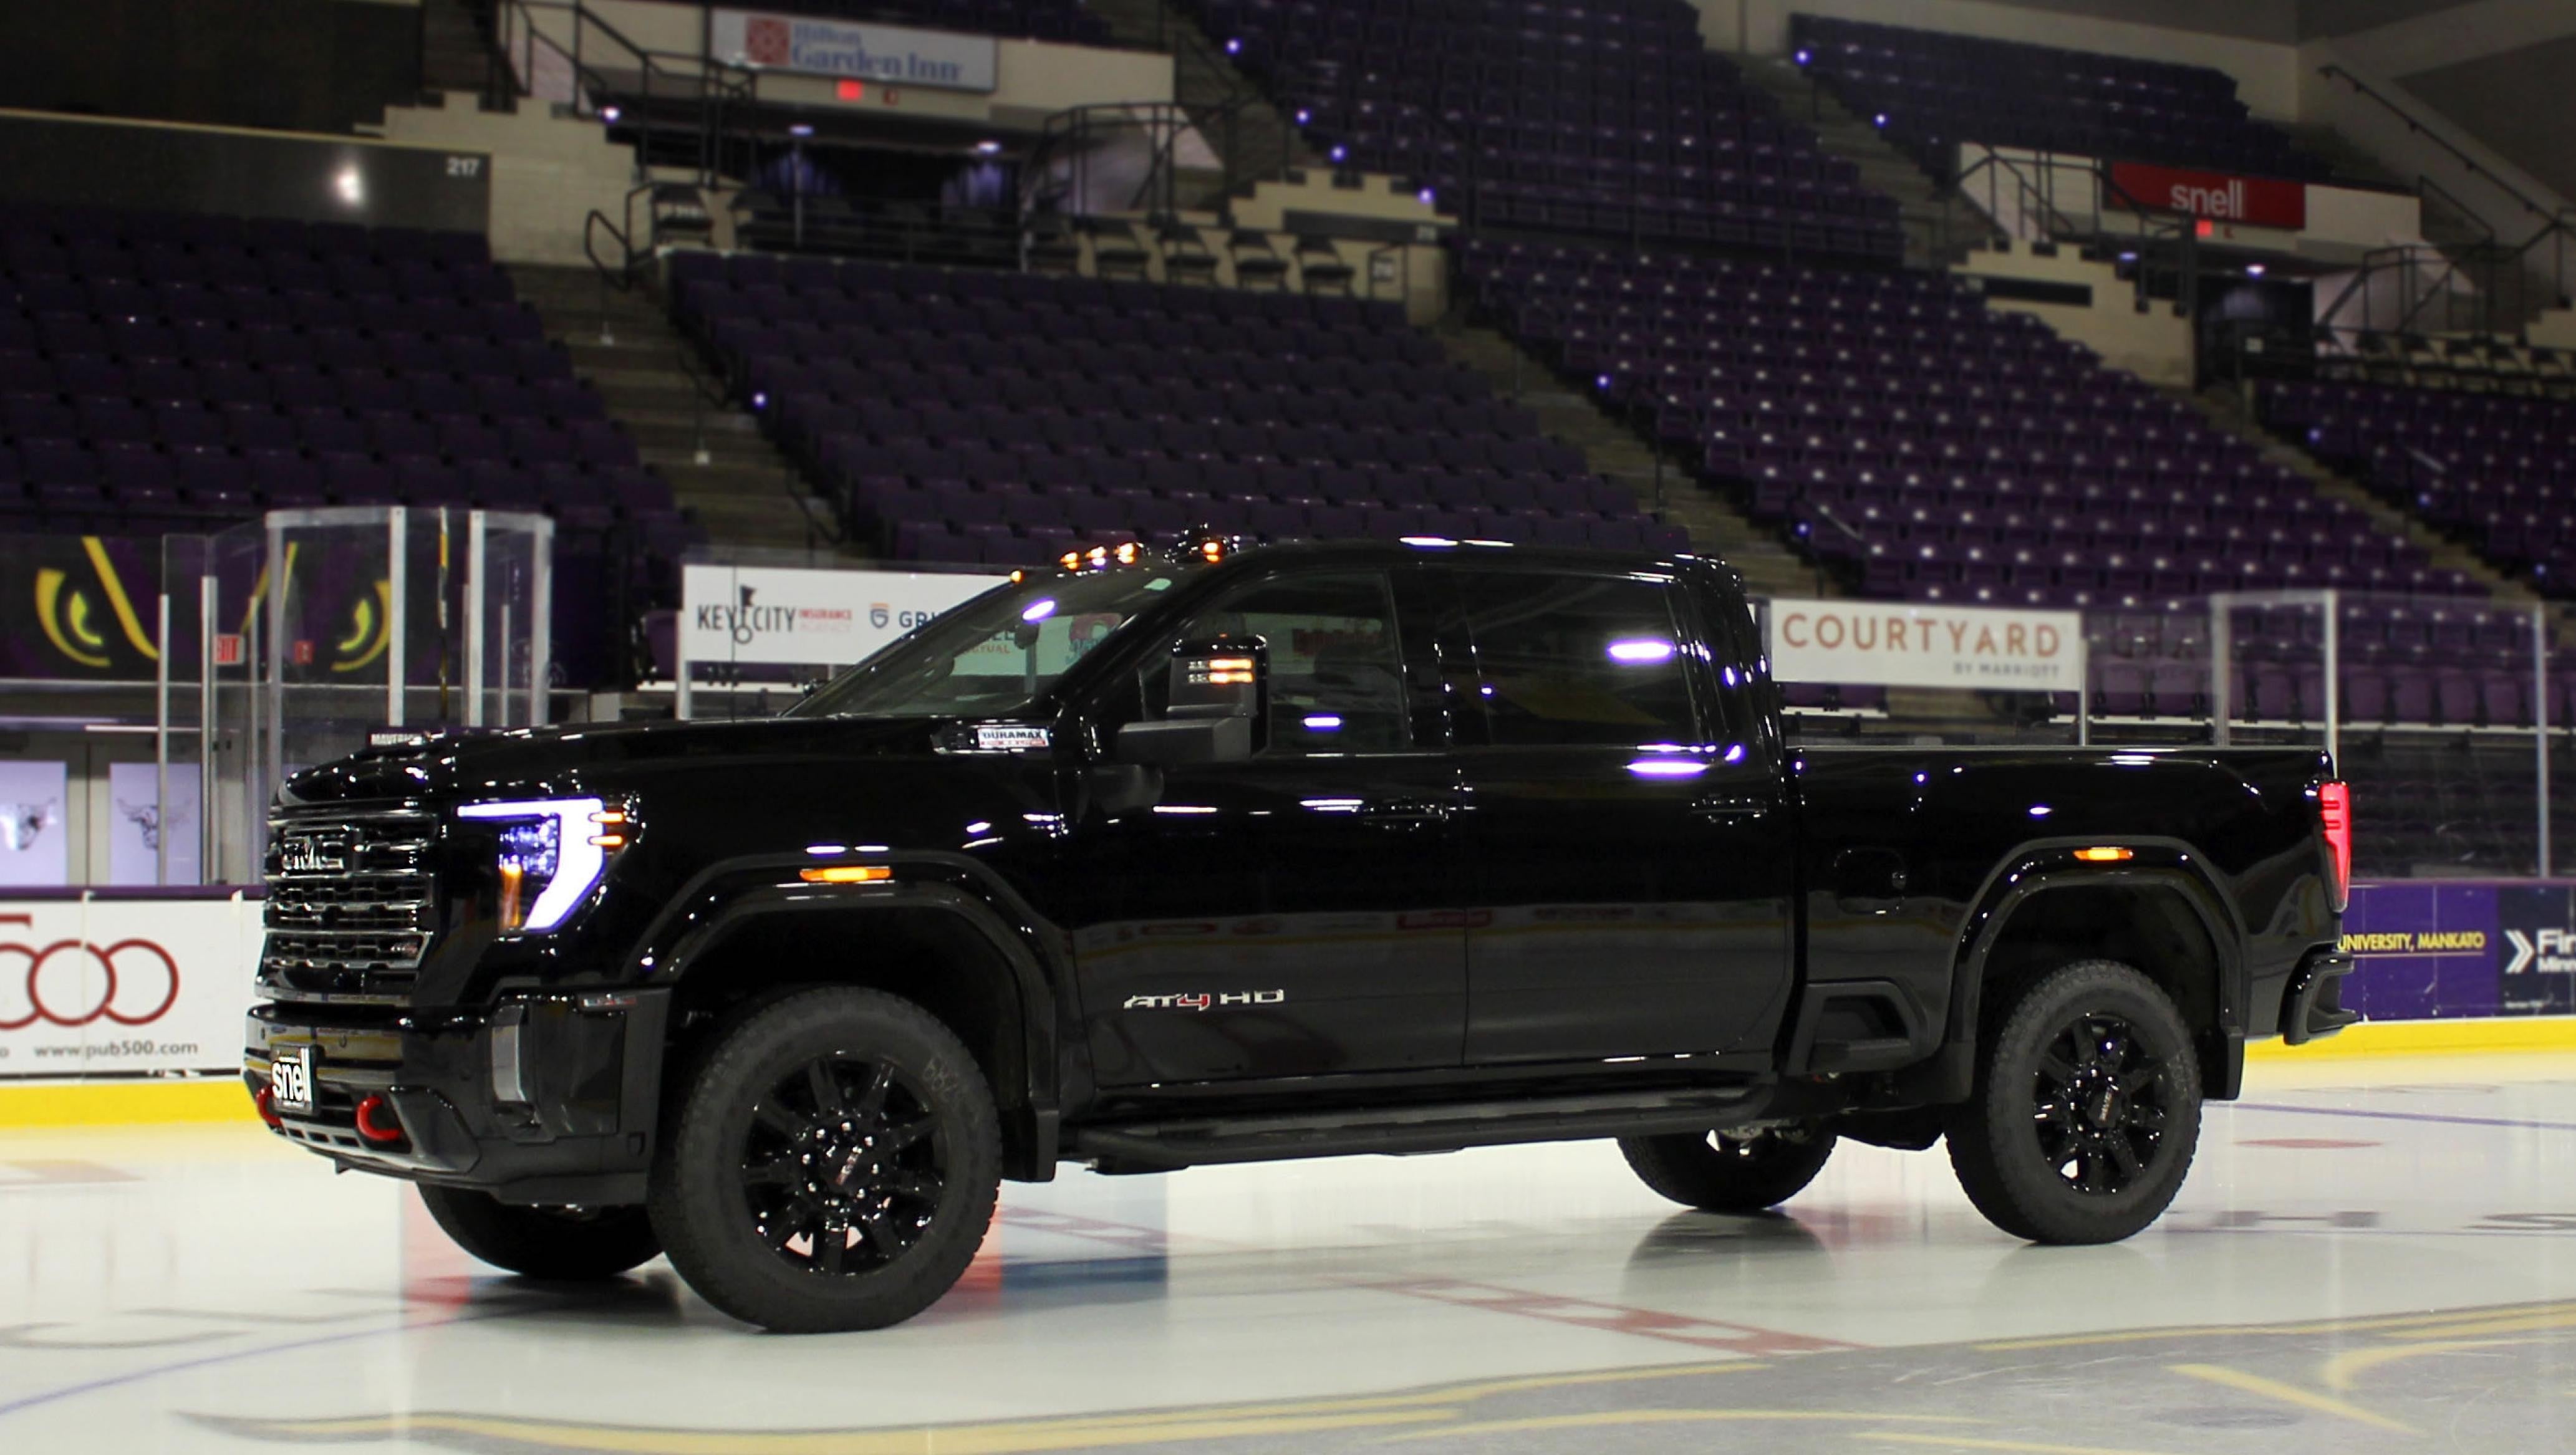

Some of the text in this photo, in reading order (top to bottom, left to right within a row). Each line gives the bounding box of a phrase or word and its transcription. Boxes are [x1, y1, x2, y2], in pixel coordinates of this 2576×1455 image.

[793, 24, 861, 45] Hilton
[792, 45, 962, 81] Garden Inn
[447, 157, 479, 176] 217
[2171, 178, 2243, 218] snell
[697, 604, 797, 633] KEY CITY
[1782, 613, 2060, 658] COURTYARD
[1954, 662, 2060, 678] BY MARRIOTT
[282, 835, 344, 870] GMC
[2418, 931, 2486, 949] MANKATO
[1124, 989, 1285, 1011] AT4 HD
[34, 1040, 198, 1060] www.pub500.com
[272, 1047, 312, 1102] snell
